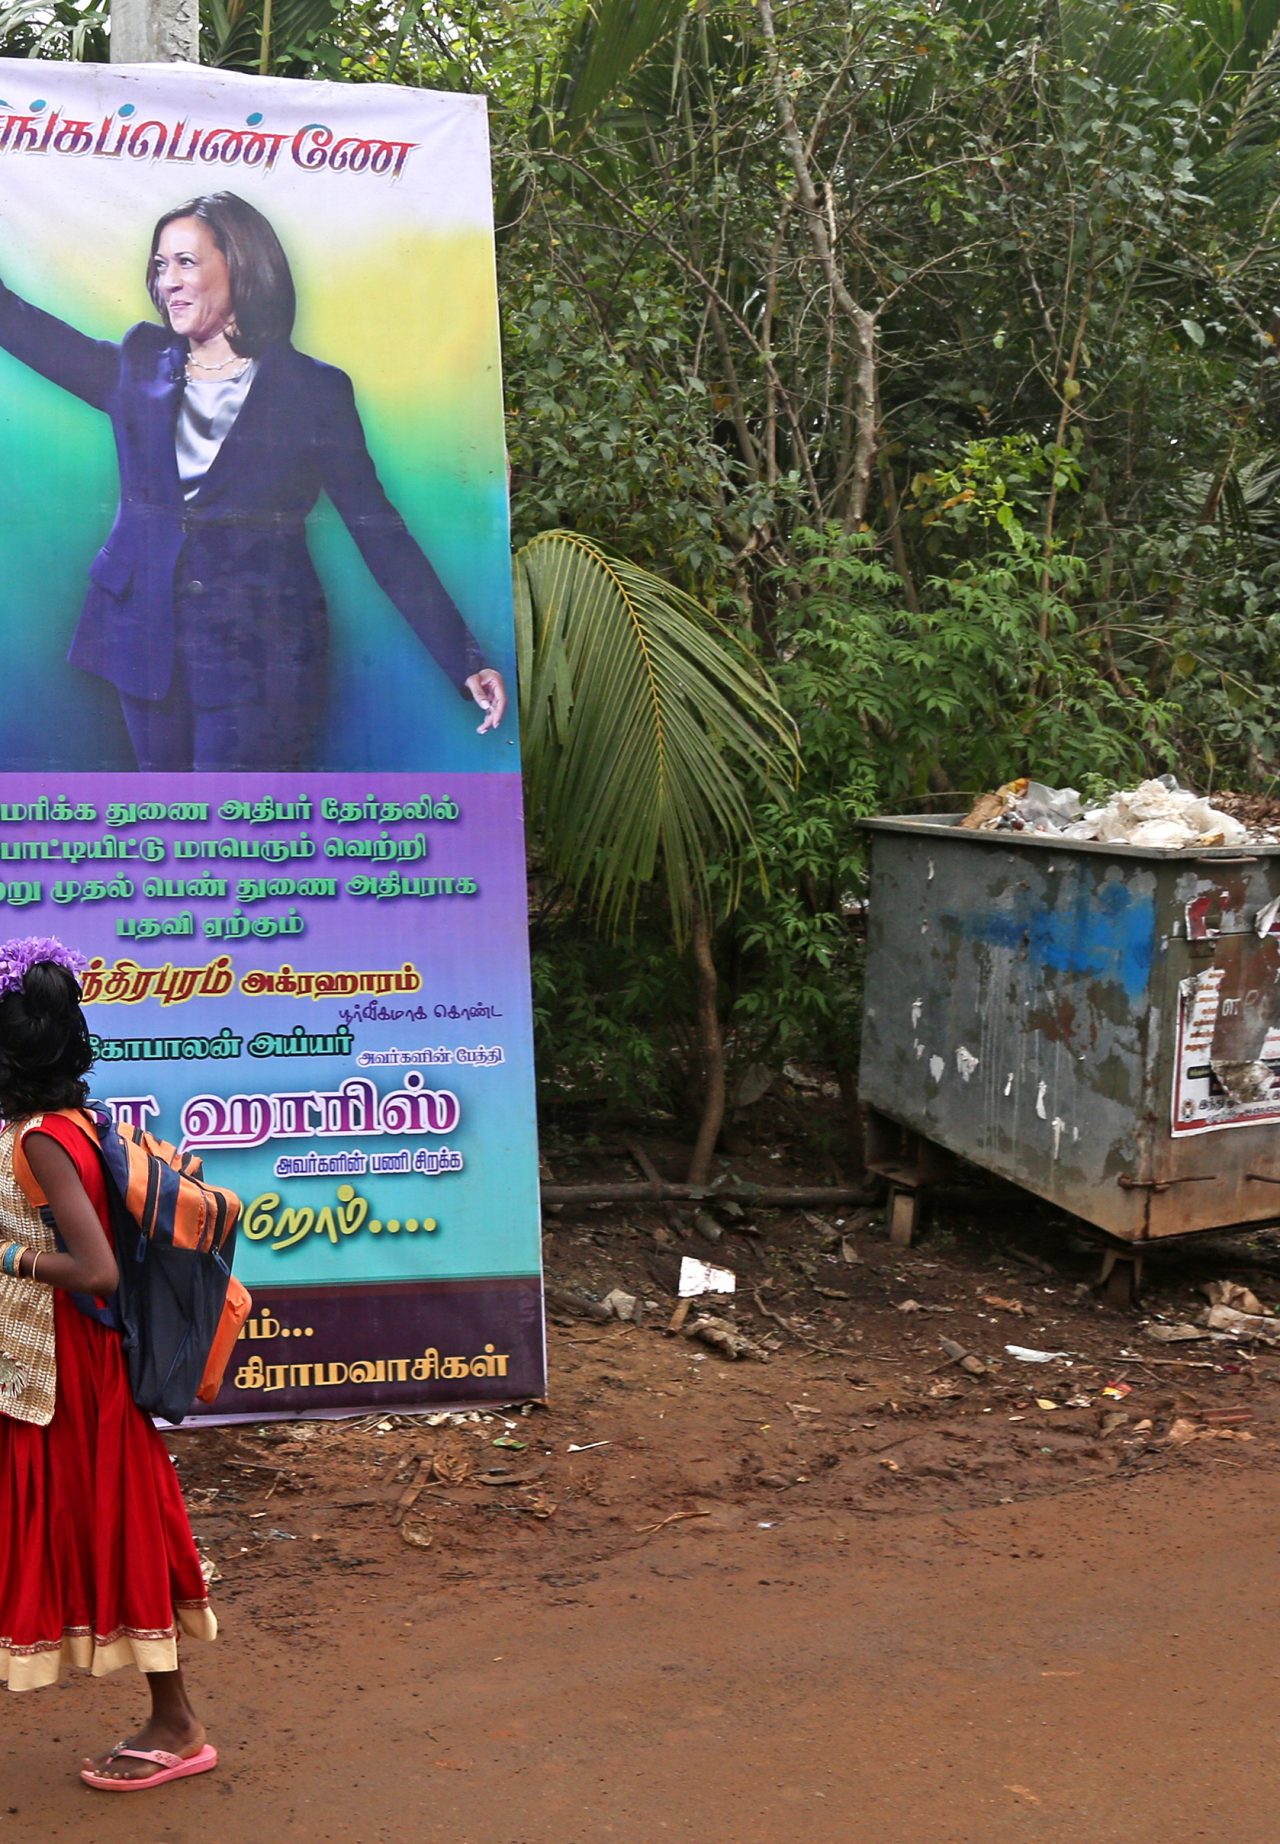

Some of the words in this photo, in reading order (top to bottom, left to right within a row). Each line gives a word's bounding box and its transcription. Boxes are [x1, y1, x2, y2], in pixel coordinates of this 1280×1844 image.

[105, 801, 210, 827] துணை
[217, 793, 313, 825] அதிபர்
[320, 793, 460, 825] தேர்தலில்
[173, 831, 317, 863] மாபெரும்
[323, 831, 427, 863] வெற்றி
[50, 870, 135, 905] முதல்
[142, 870, 228, 898] பெண்
[235, 876, 338, 903] துணை
[344, 870, 478, 900] அதிபராக
[115, 910, 194, 941] பதவி
[202, 906, 305, 940] ஏற்கும்
[240, 962, 422, 1001] அக்ரஹாரம்
[338, 999, 428, 1026] பூர்வீகமாக
[433, 1001, 503, 1021] கொண்ட
[248, 1024, 354, 1058] அய்யர்
[358, 1047, 451, 1067] அவர்களின்
[456, 1045, 504, 1066] பேத்தி
[181, 1071, 460, 1151] ஹாரிஸ்
[276, 1150, 367, 1177] அவர்களின்
[370, 1149, 412, 1174] பணி
[413, 1146, 462, 1175] சிறக்க
[234, 1343, 510, 1392] கிராமவாசிகள்
